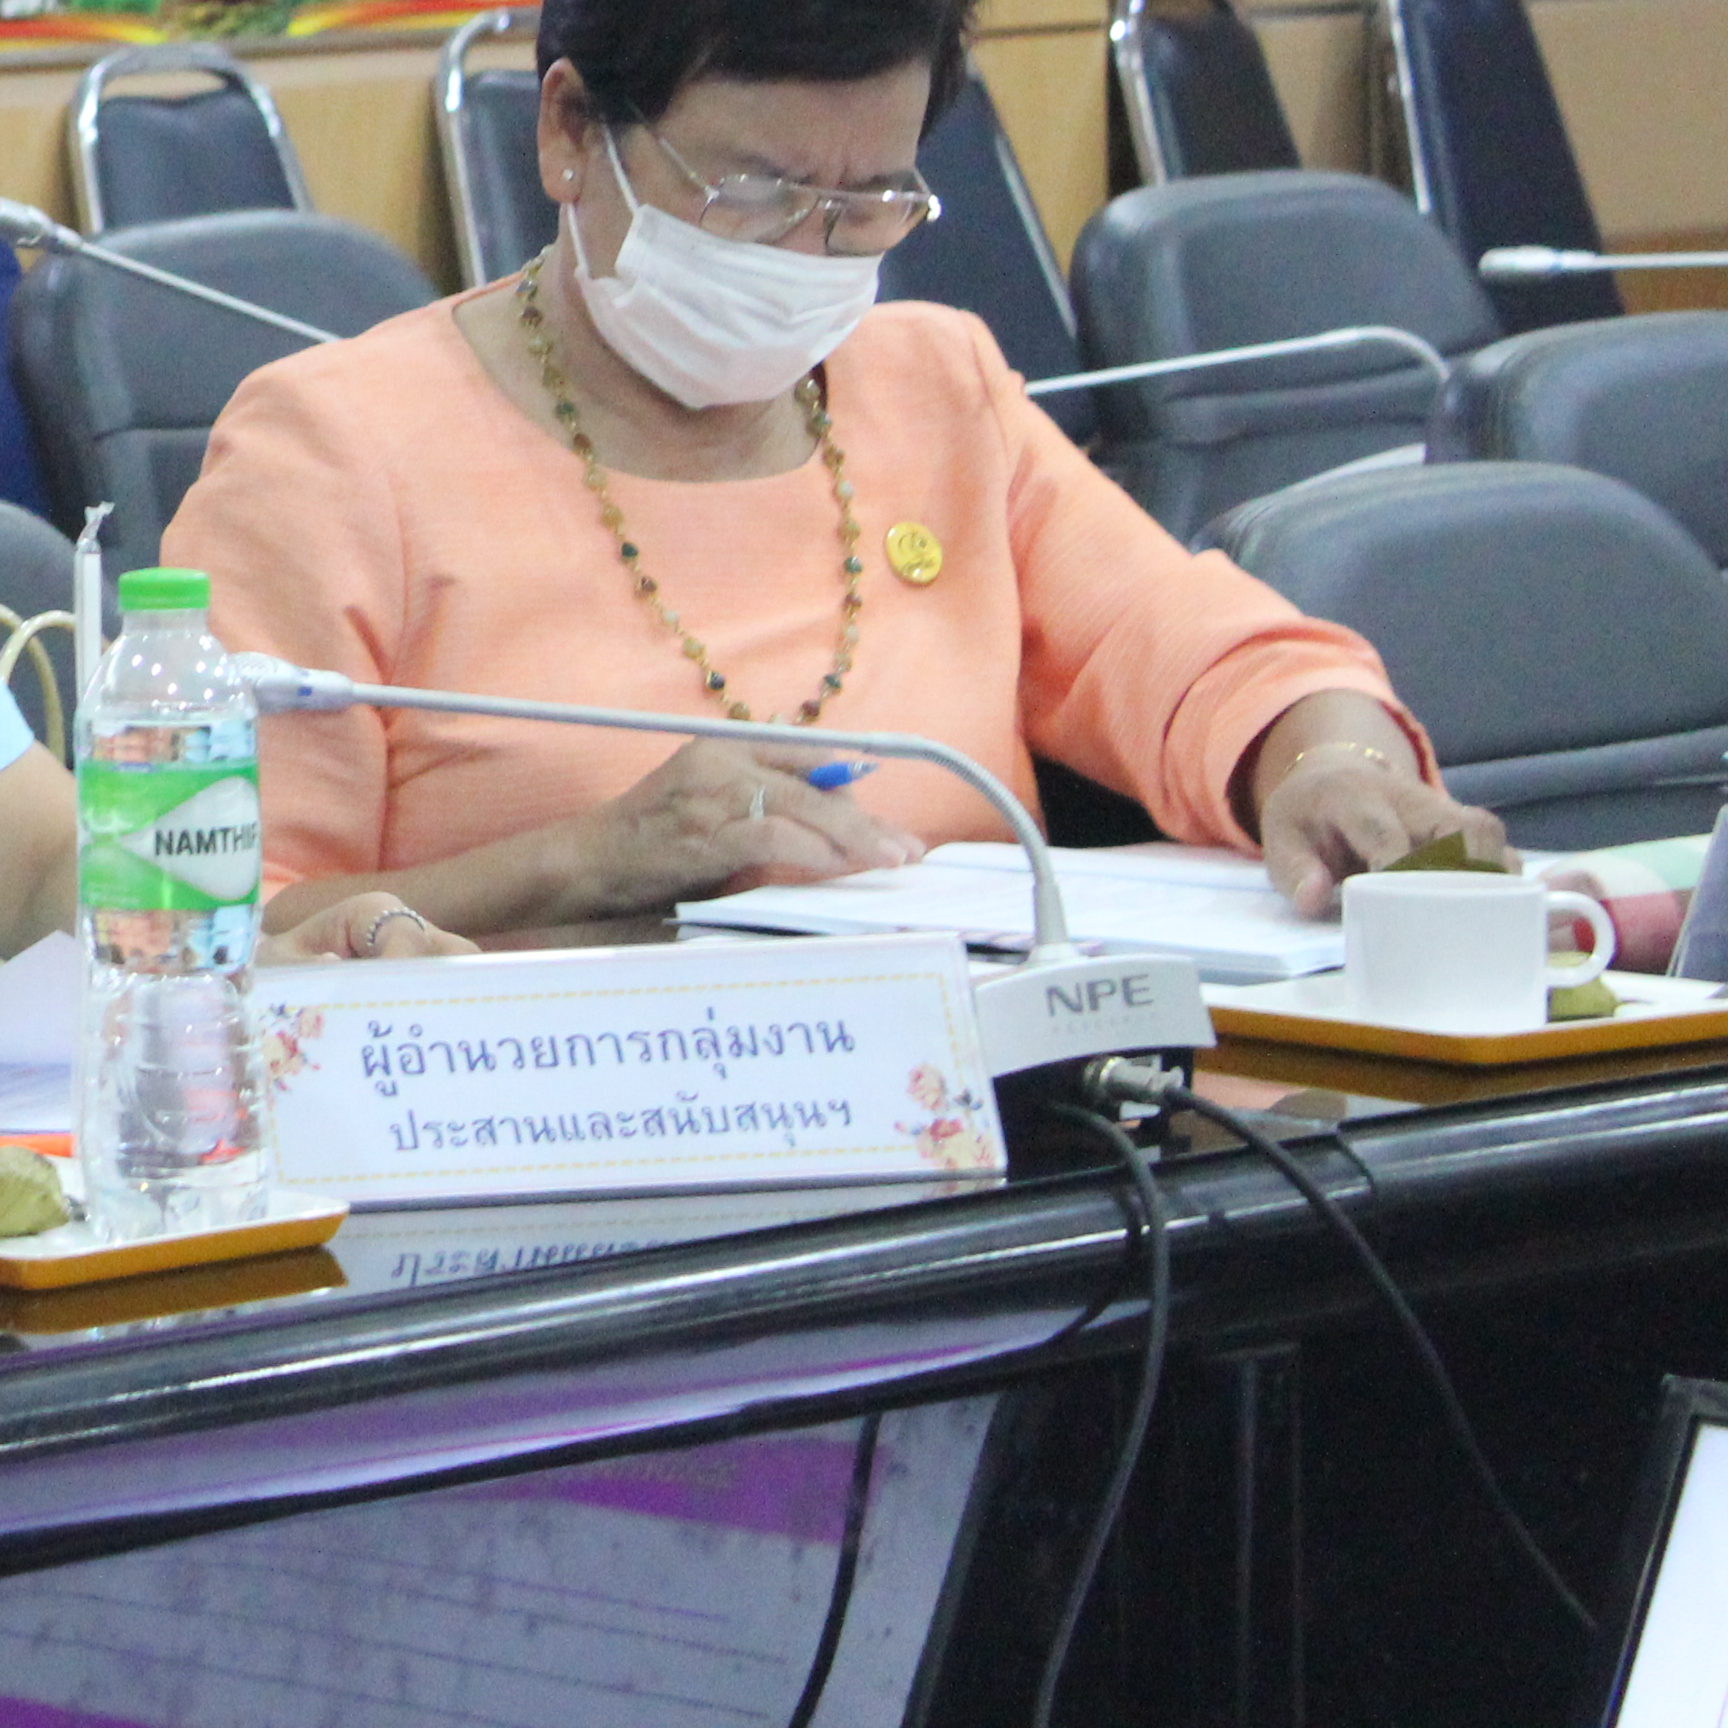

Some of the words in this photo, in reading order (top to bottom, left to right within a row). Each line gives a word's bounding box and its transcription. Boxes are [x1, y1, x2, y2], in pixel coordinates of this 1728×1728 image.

[1045, 973, 1154, 1018] NPE
[359, 1006, 856, 1098] ผู้อำนวยการกลุ่มงาน
[389, 1089, 853, 1153] ประสานและสนับสนุนฯ
